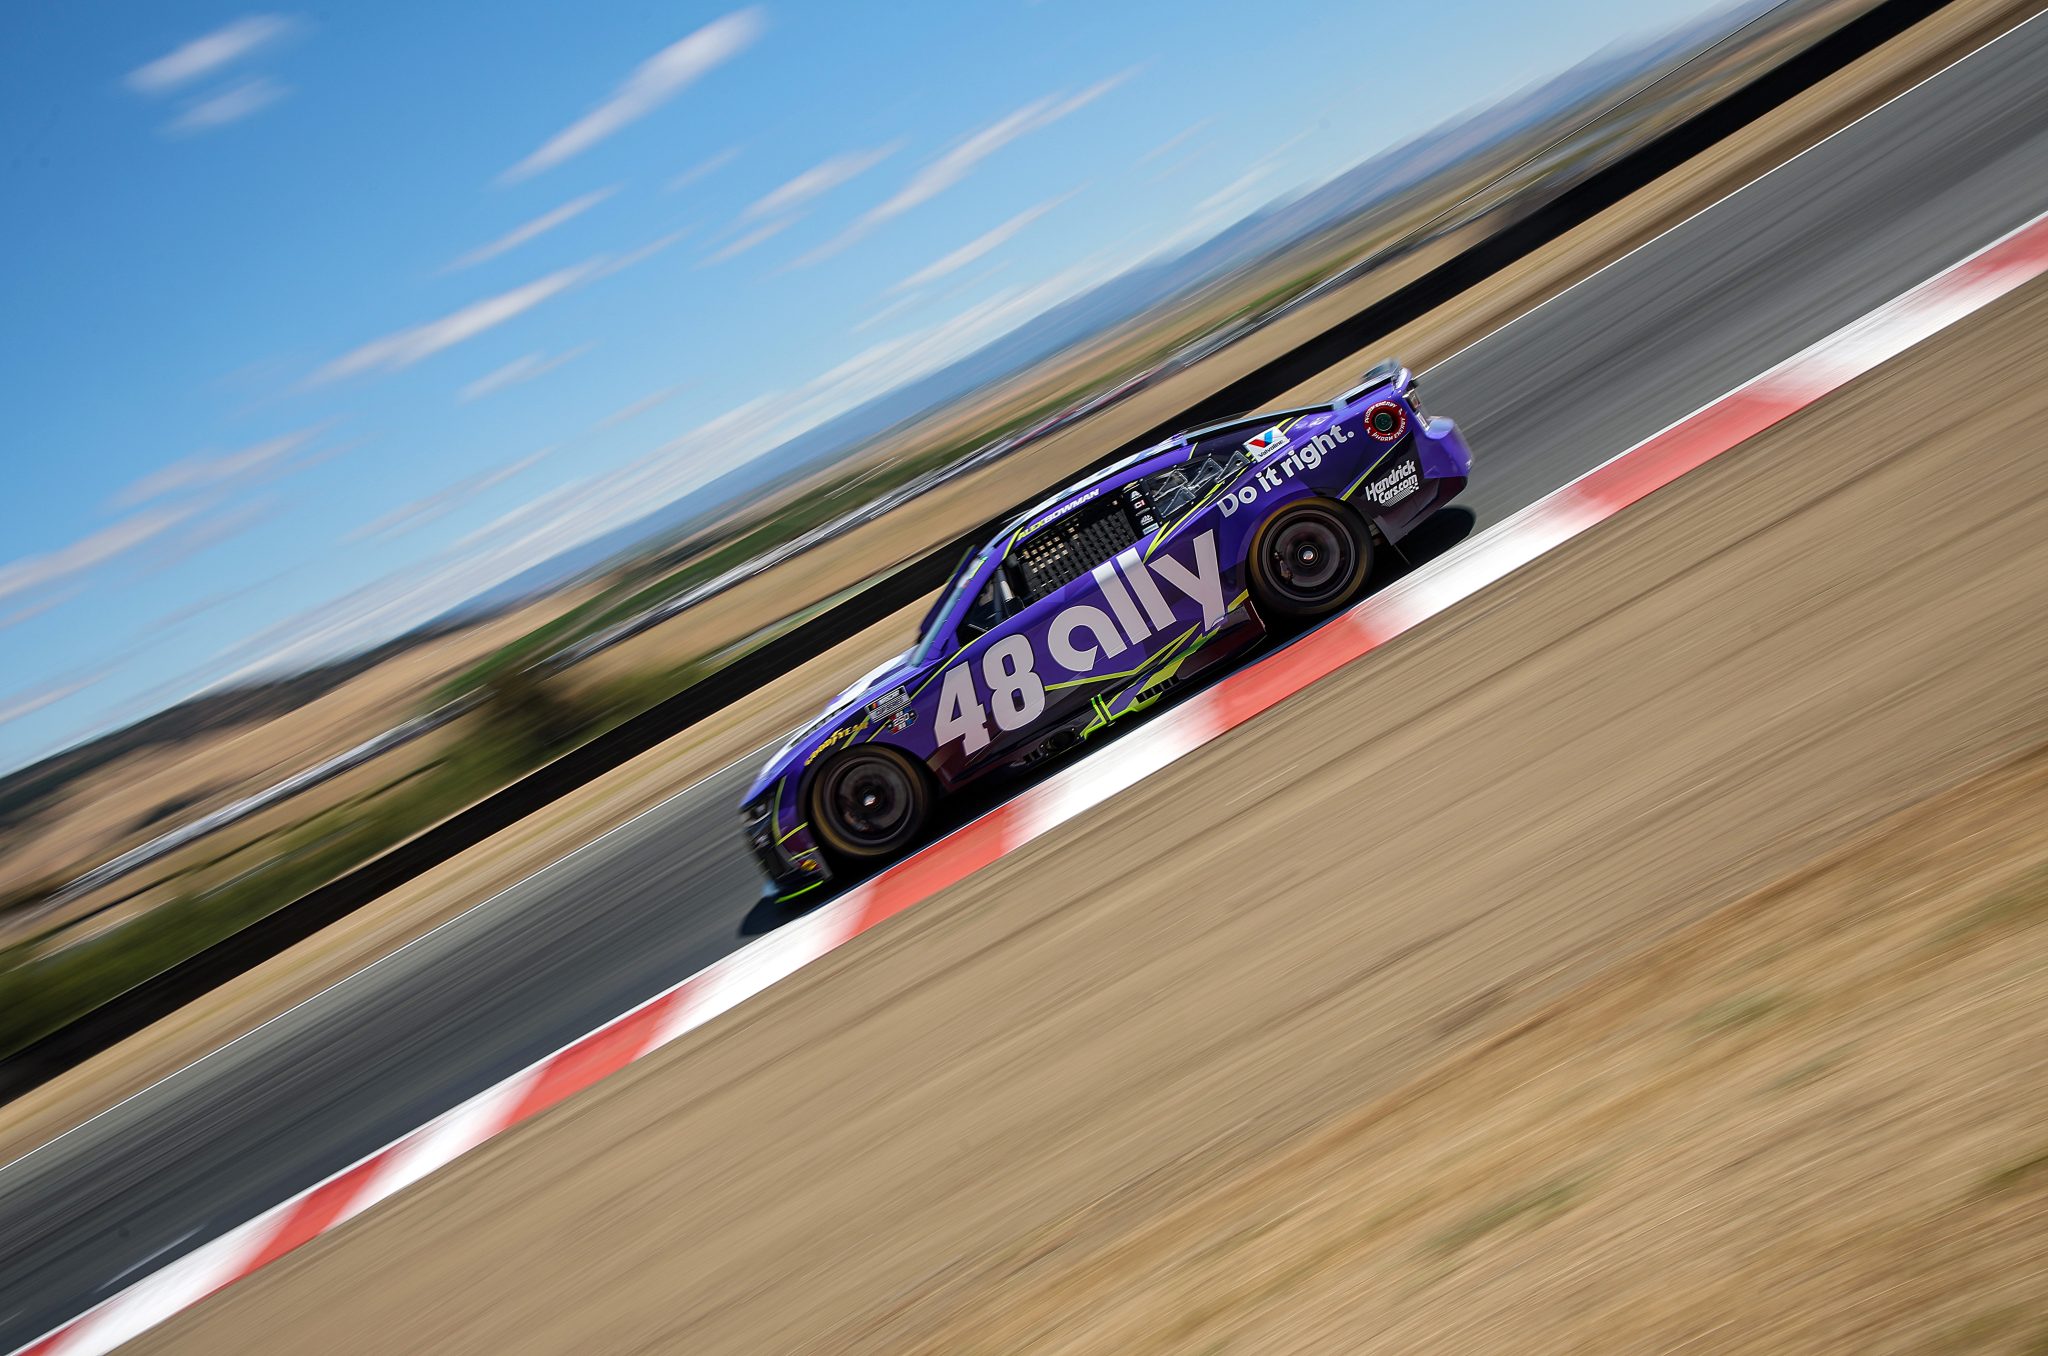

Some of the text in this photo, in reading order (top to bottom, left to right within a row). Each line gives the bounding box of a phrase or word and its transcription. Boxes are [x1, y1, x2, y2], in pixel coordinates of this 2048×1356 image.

[1216, 424, 1355, 518] Do it right.
[1364, 459, 1416, 502] Hendrick
[1378, 474, 1418, 504] Cars.com
[1047, 528, 1226, 672] ally
[933, 633, 1046, 757] 48
